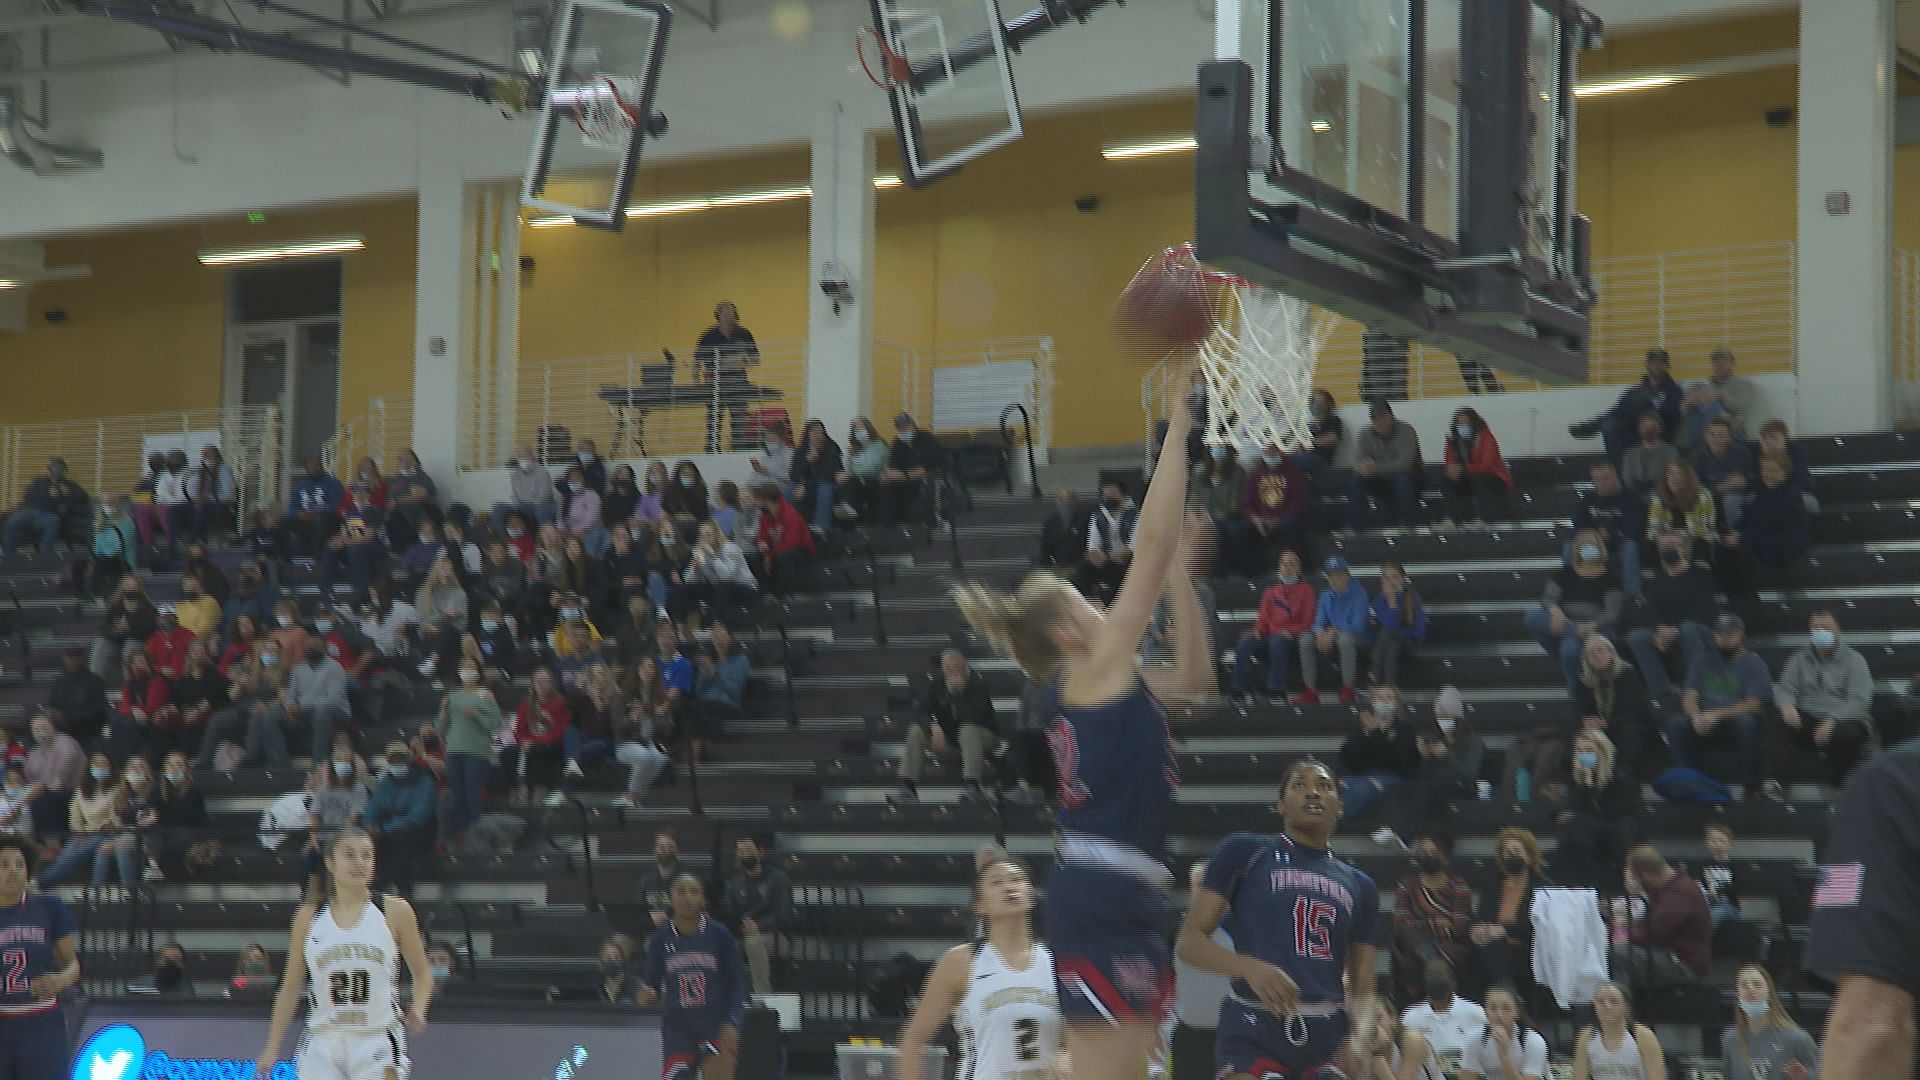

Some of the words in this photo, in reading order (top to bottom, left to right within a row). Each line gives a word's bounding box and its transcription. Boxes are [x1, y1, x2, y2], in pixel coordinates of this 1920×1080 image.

[1293, 897, 1337, 962] 15
[3, 948, 28, 992] 2
[328, 969, 370, 1004] 20
[678, 971, 706, 1007] 13
[1014, 1018, 1037, 1061] 2
